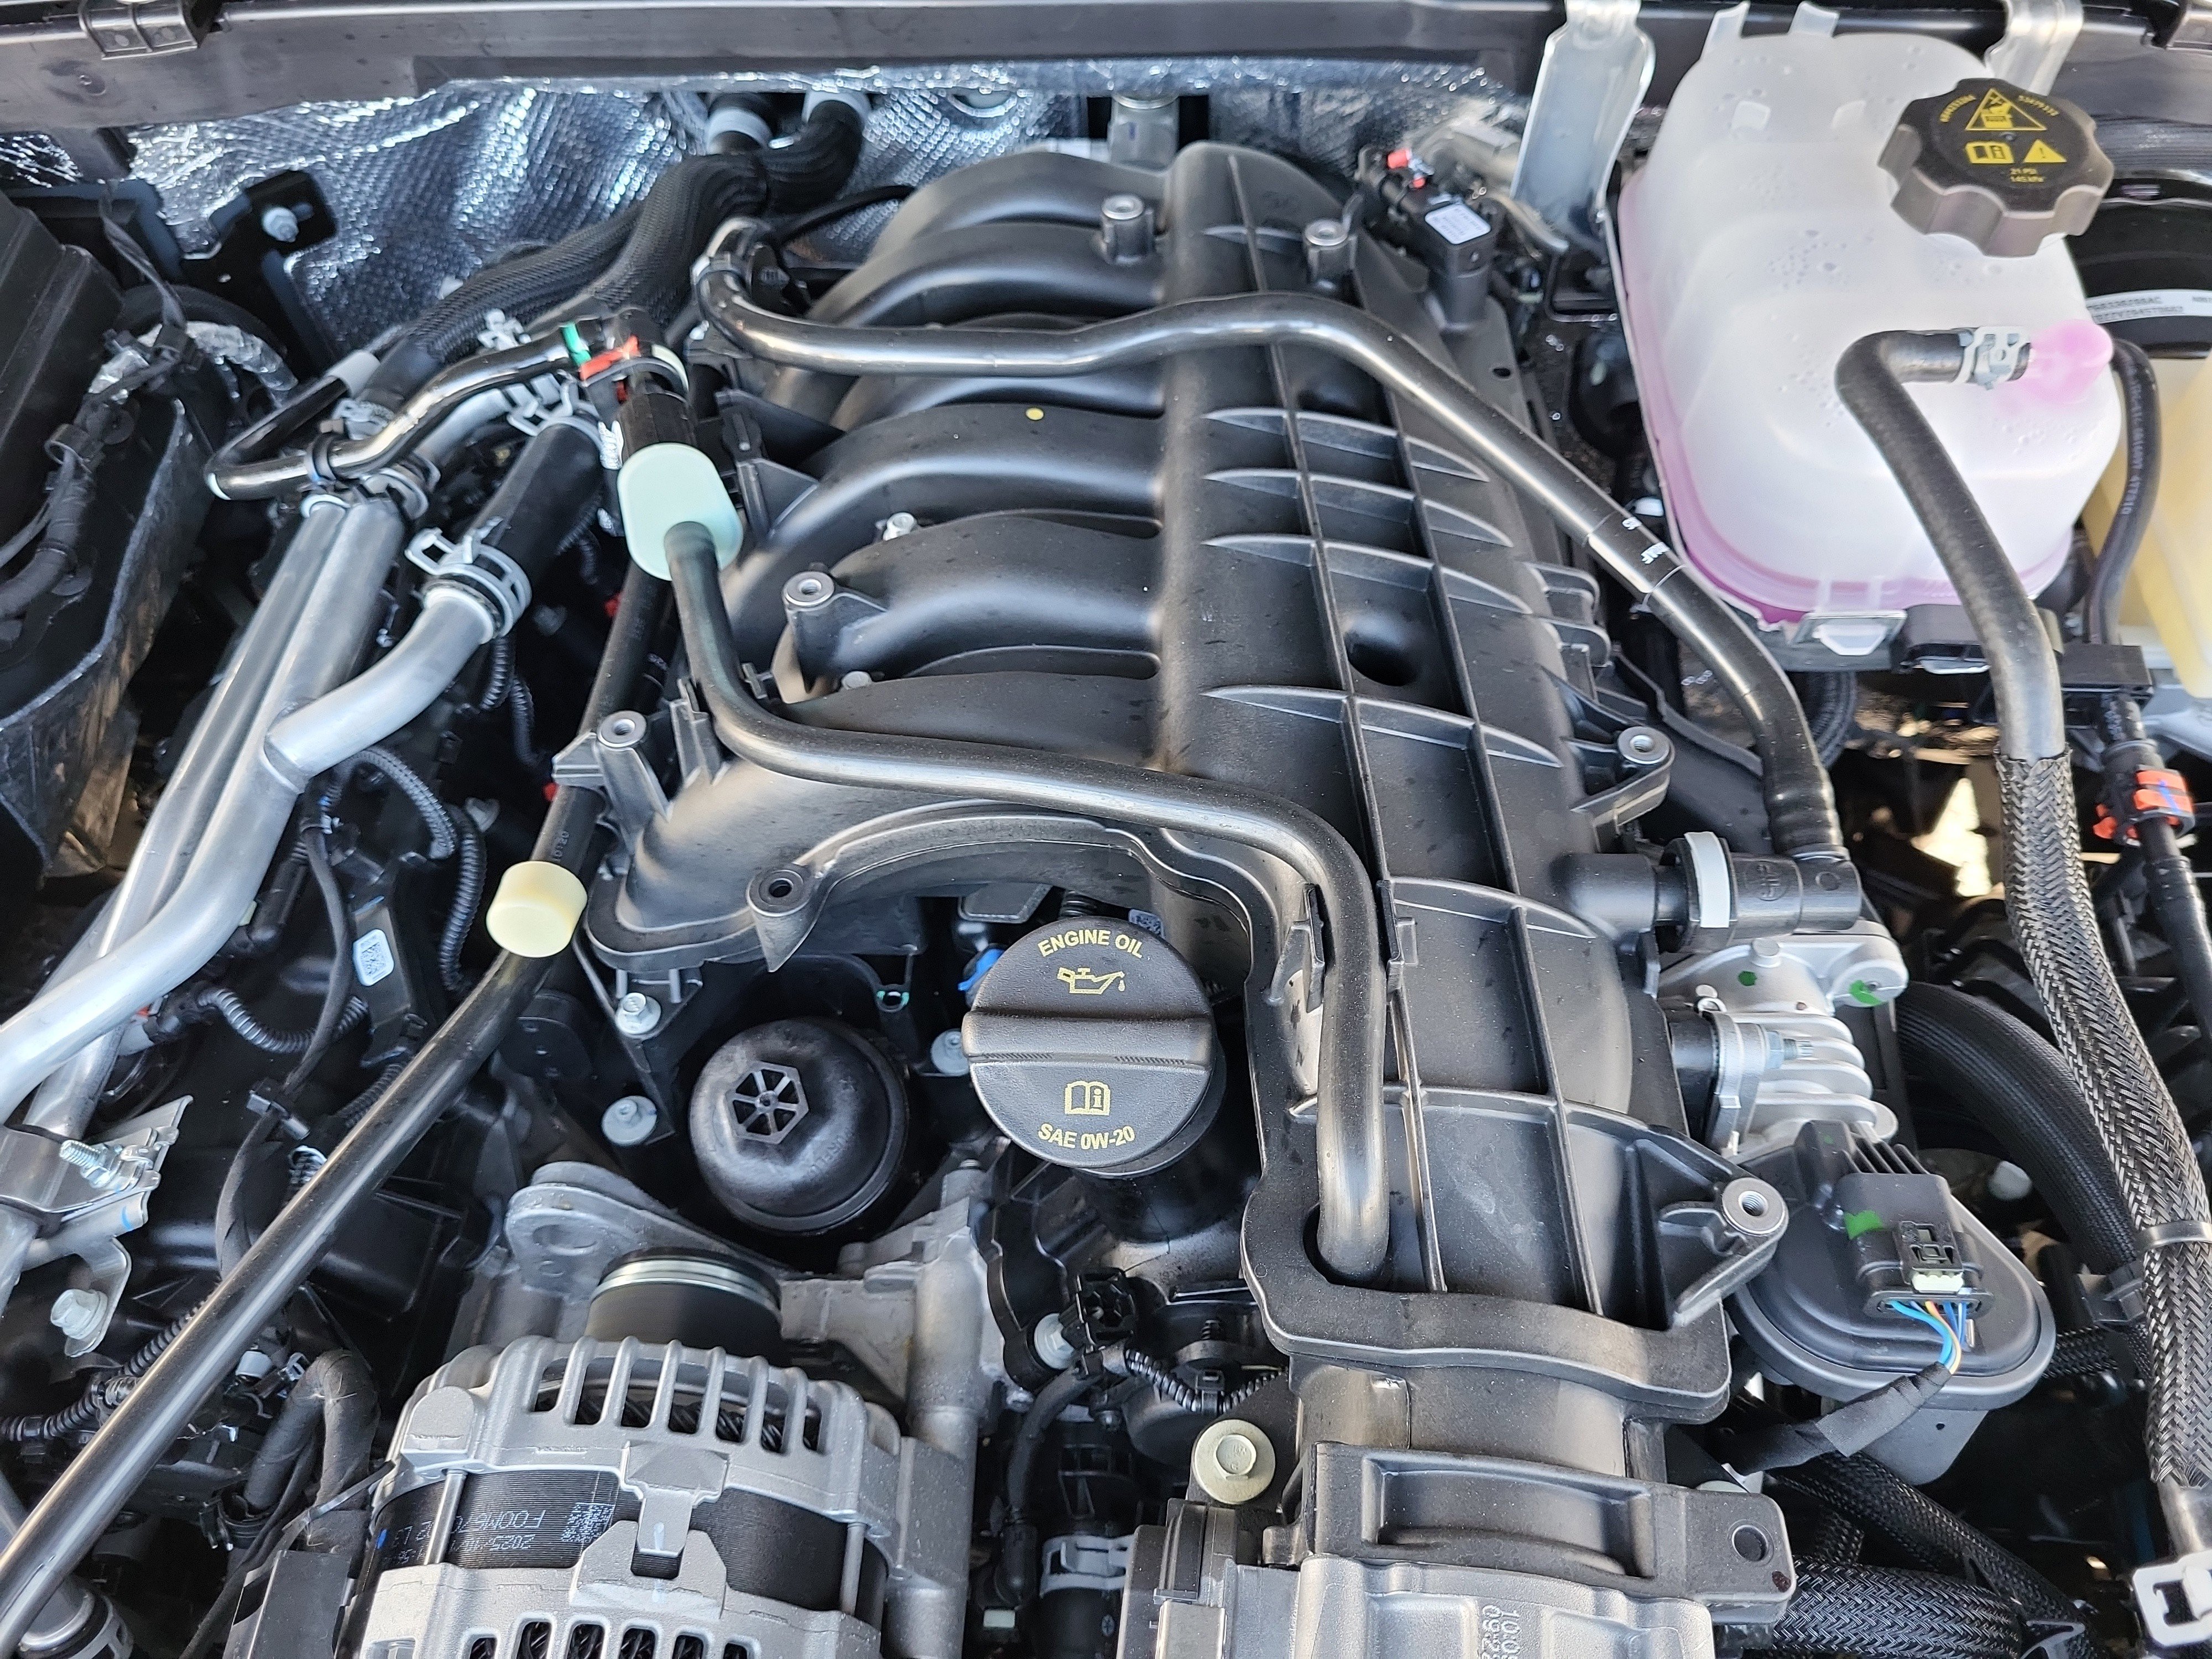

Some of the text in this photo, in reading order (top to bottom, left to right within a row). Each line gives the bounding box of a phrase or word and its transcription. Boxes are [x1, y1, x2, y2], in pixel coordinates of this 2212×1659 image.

[1037, 929, 1143, 959] ENGINE OIL
[1038, 1123, 1135, 1150] SAE 0W-20
[1500, 1609, 1522, 1659] 10:0
